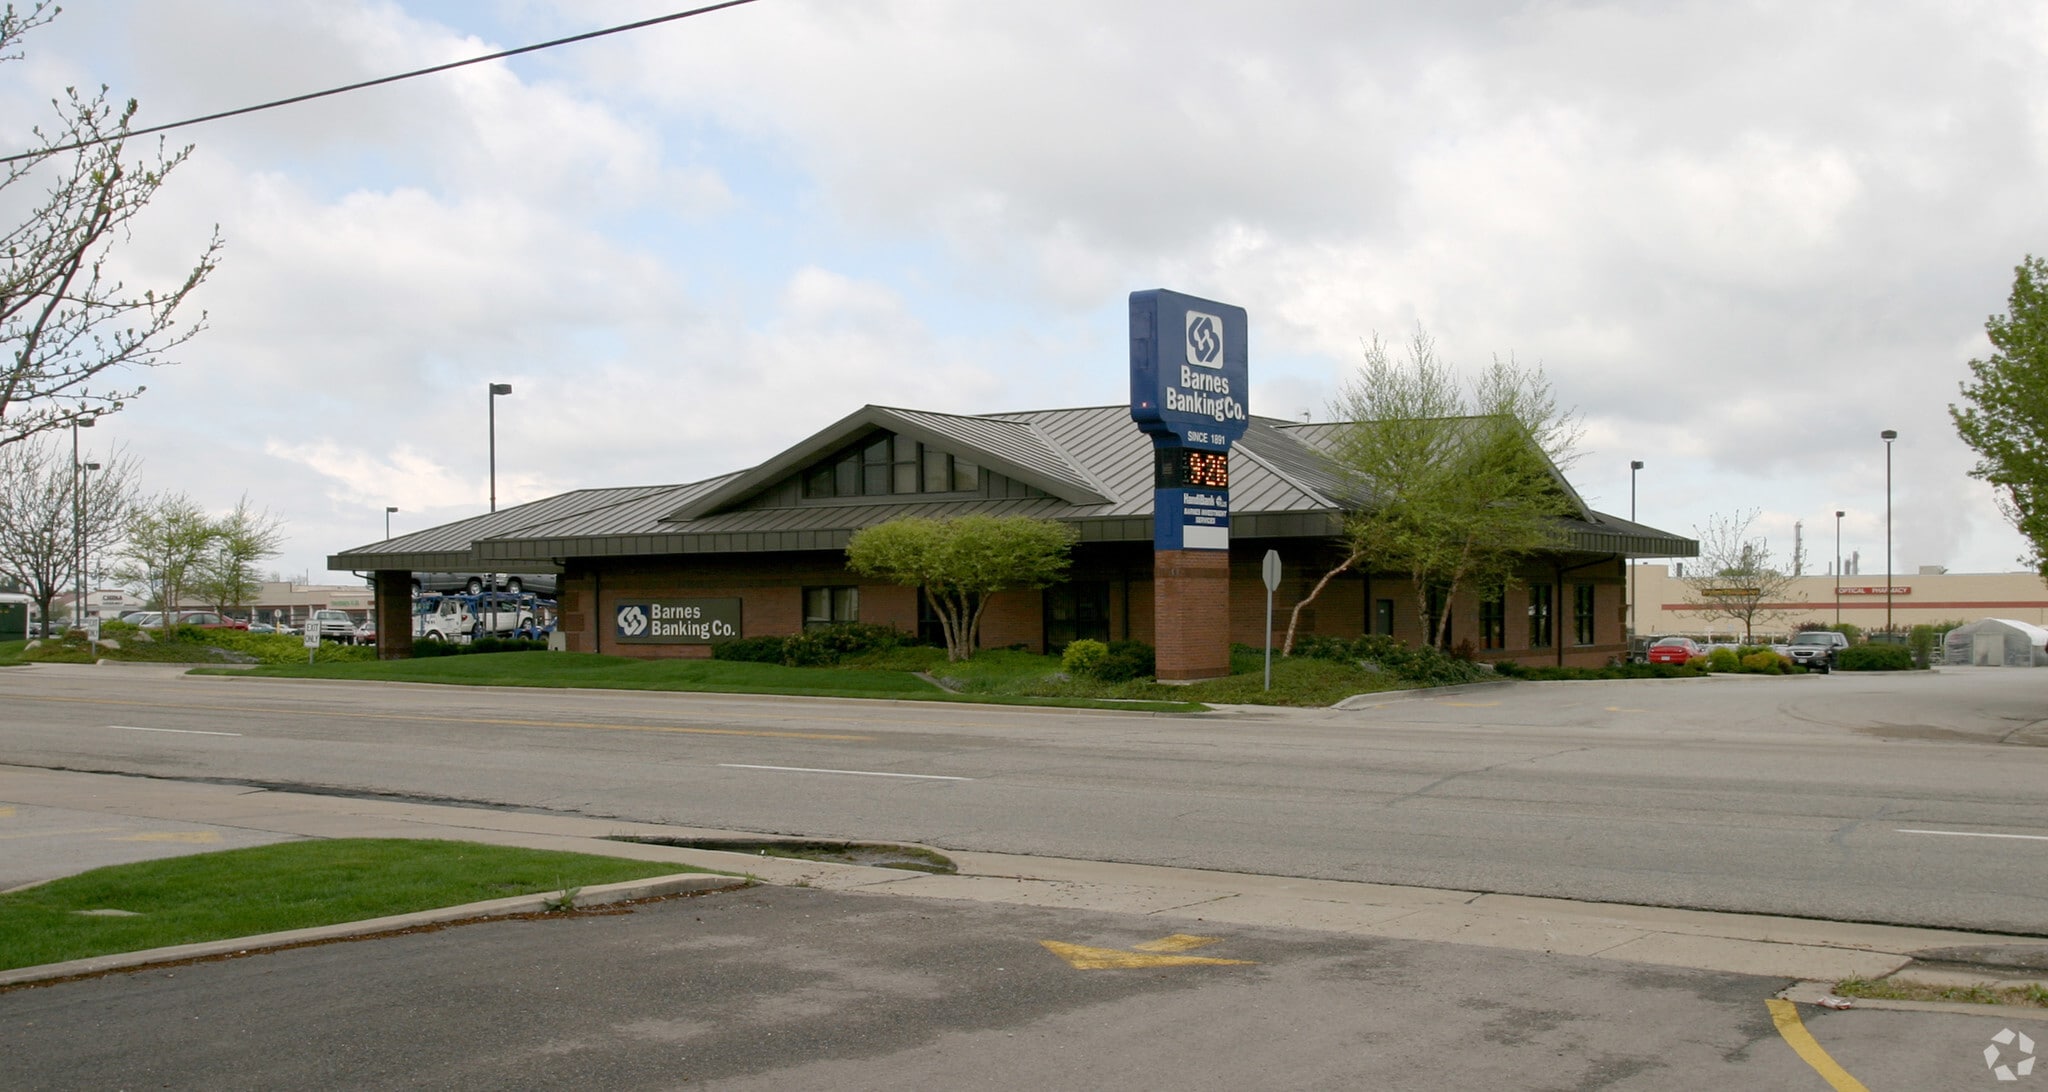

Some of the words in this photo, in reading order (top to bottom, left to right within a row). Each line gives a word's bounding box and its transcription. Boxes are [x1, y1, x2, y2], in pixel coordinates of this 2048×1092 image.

[1181, 365, 1229, 394] Barnes
[1187, 430, 1208, 443] SINCE
[1210, 434, 1226, 445] 1891
[1190, 453, 1227, 486] 9:26
[651, 603, 701, 619] Barnes
[306, 623, 319, 632] EXIT
[651, 620, 710, 639] Banking
[712, 620, 736, 636] Co.
[304, 634, 319, 644] ONLY
